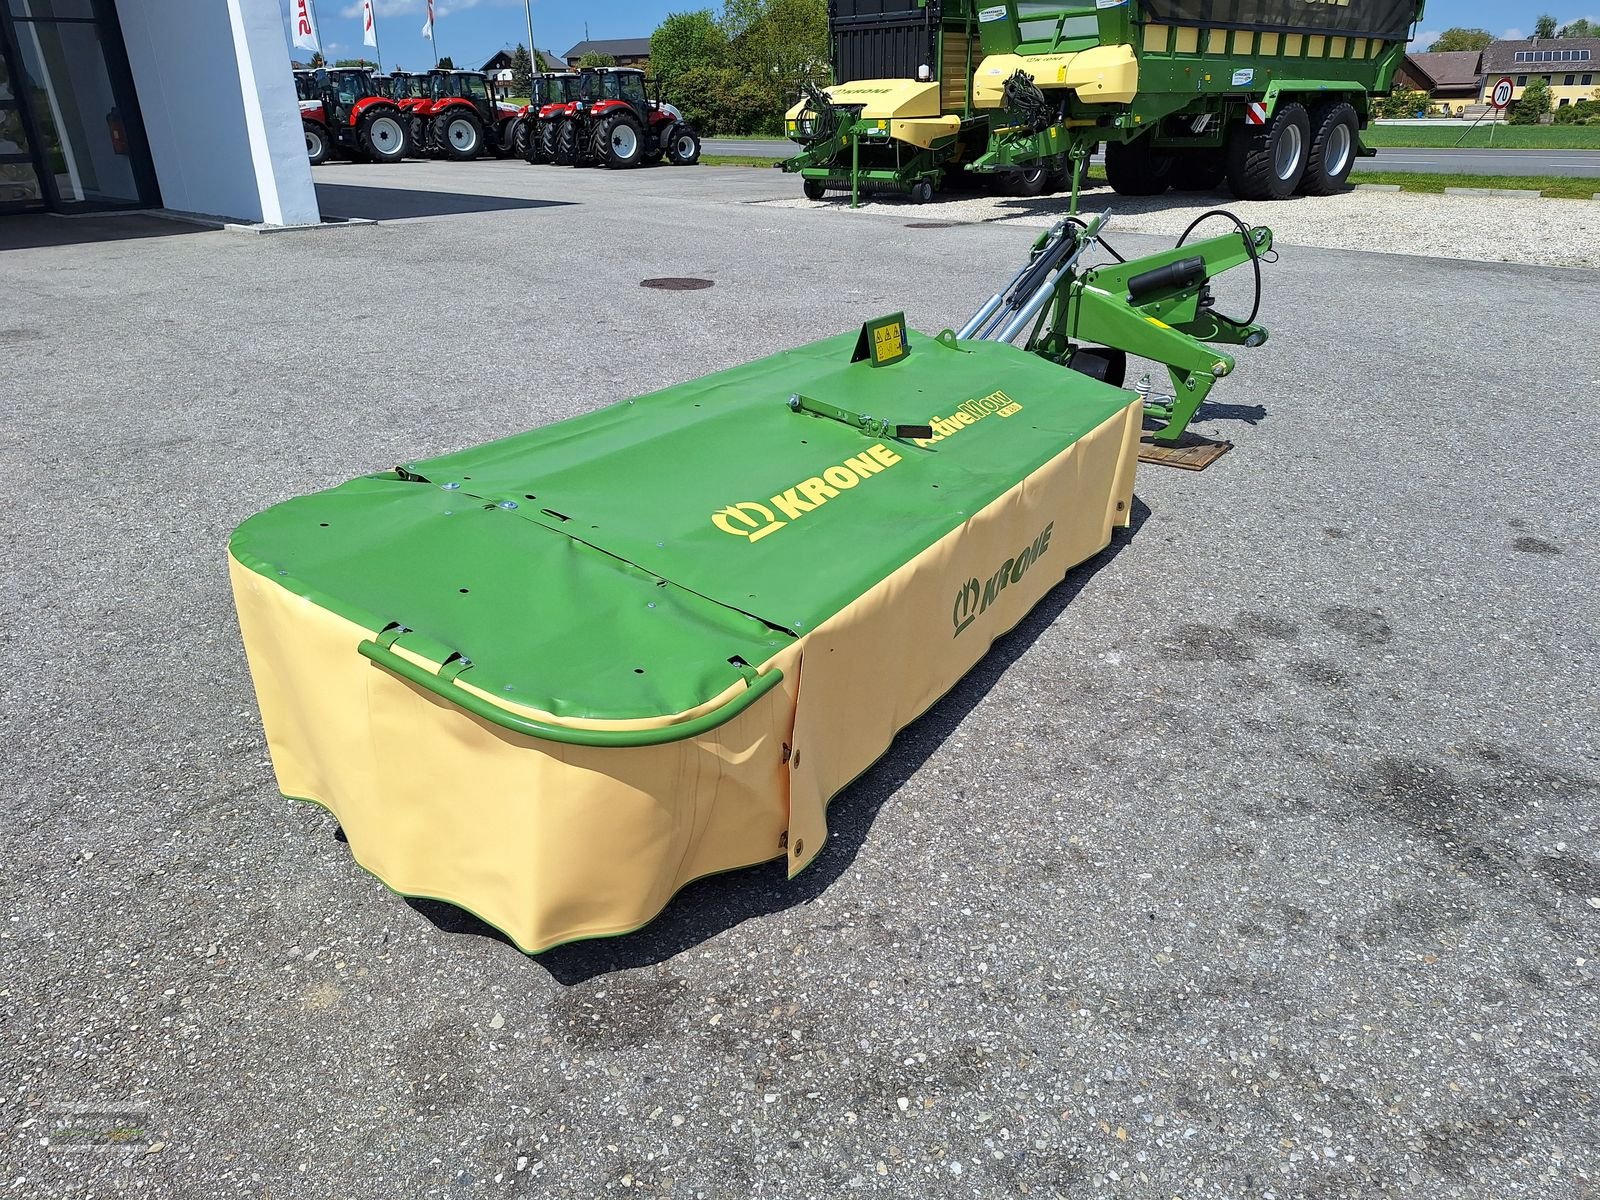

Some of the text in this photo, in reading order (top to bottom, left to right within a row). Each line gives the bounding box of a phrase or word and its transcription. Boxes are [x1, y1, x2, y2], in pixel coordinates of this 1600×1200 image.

[1497, 86, 1509, 101] 70
[769, 443, 903, 520] KRONE
[979, 520, 1055, 615] KRONE
